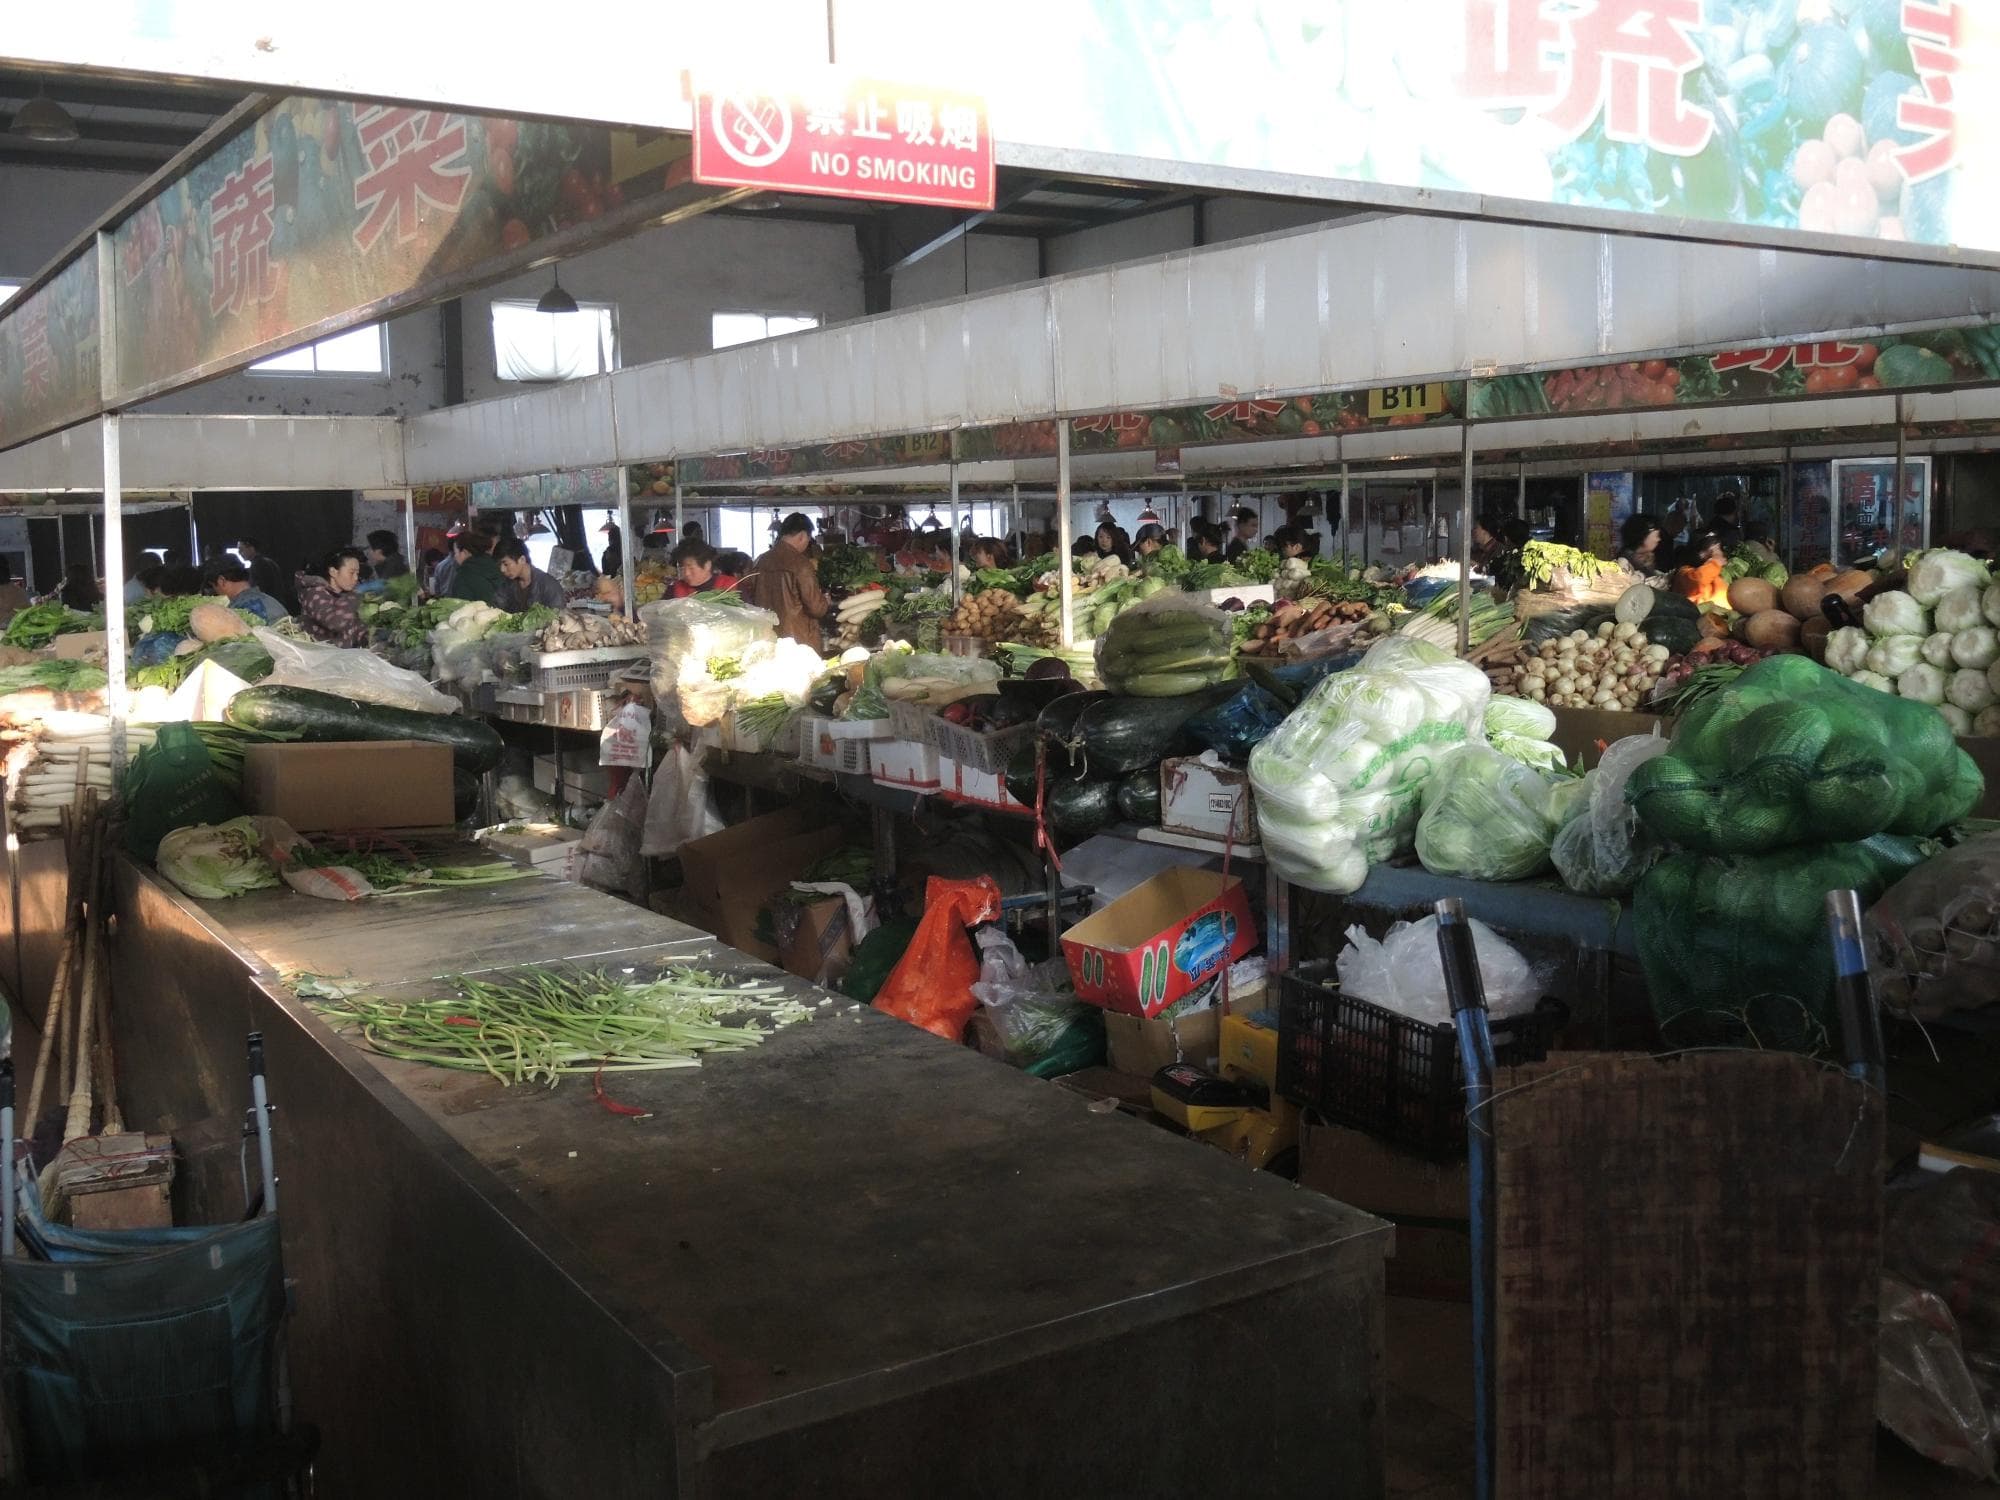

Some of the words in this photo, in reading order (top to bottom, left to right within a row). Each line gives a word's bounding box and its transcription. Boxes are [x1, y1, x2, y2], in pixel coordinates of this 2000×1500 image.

[806, 94, 978, 153] 禁止吸烟
[811, 151, 850, 177] NO
[856, 158, 976, 190] SMOKING
[1381, 384, 1427, 411] B11
[912, 432, 937, 452] B12
